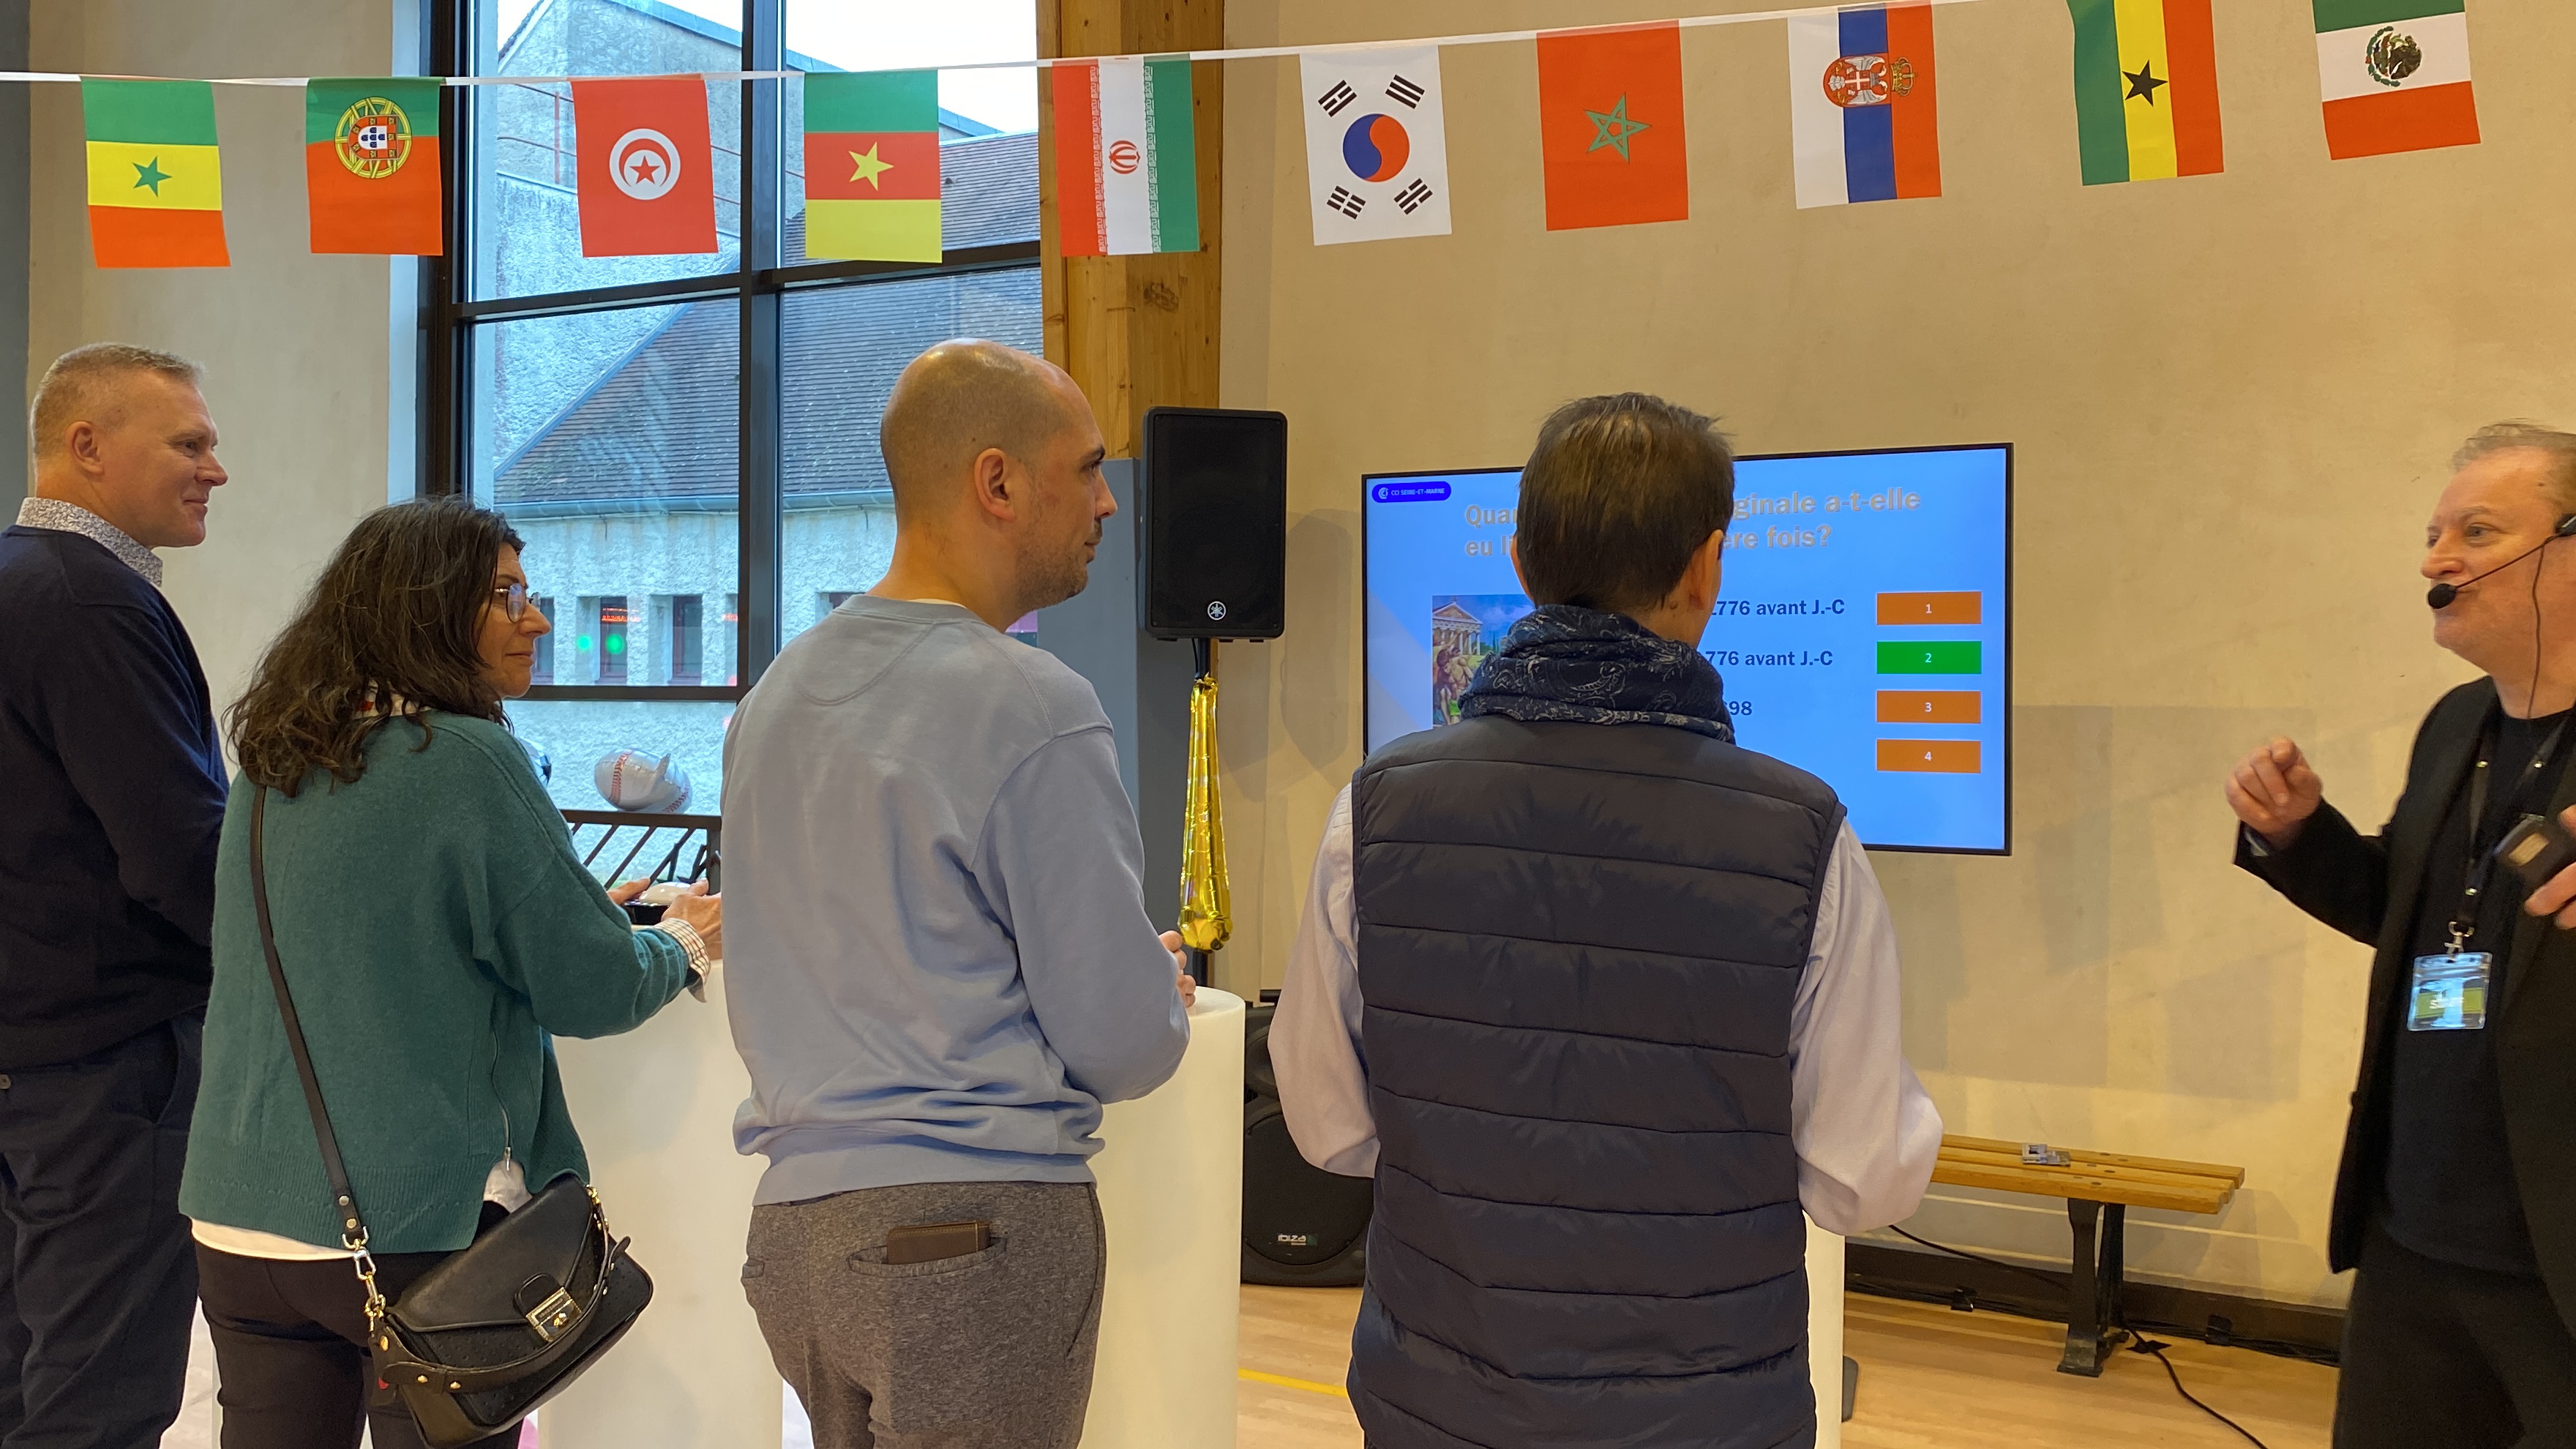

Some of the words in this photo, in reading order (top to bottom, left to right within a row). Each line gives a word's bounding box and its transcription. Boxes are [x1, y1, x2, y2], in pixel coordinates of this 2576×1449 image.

[1825, 487, 1921, 512] a-t-elle
[1466, 540, 1493, 557] eu
[1767, 524, 1832, 548] fois?
[1712, 600, 1751, 615] 776
[1756, 600, 1807, 615] avant
[1811, 599, 1845, 615] J.-C
[1925, 603, 1933, 614] 1
[1745, 651, 1795, 666] avant
[1800, 650, 1833, 666] J.-C
[1925, 653, 1932, 663] 2
[1724, 700, 1753, 716] 98
[1925, 702, 1932, 712] 3
[1924, 751, 1933, 761] 4
